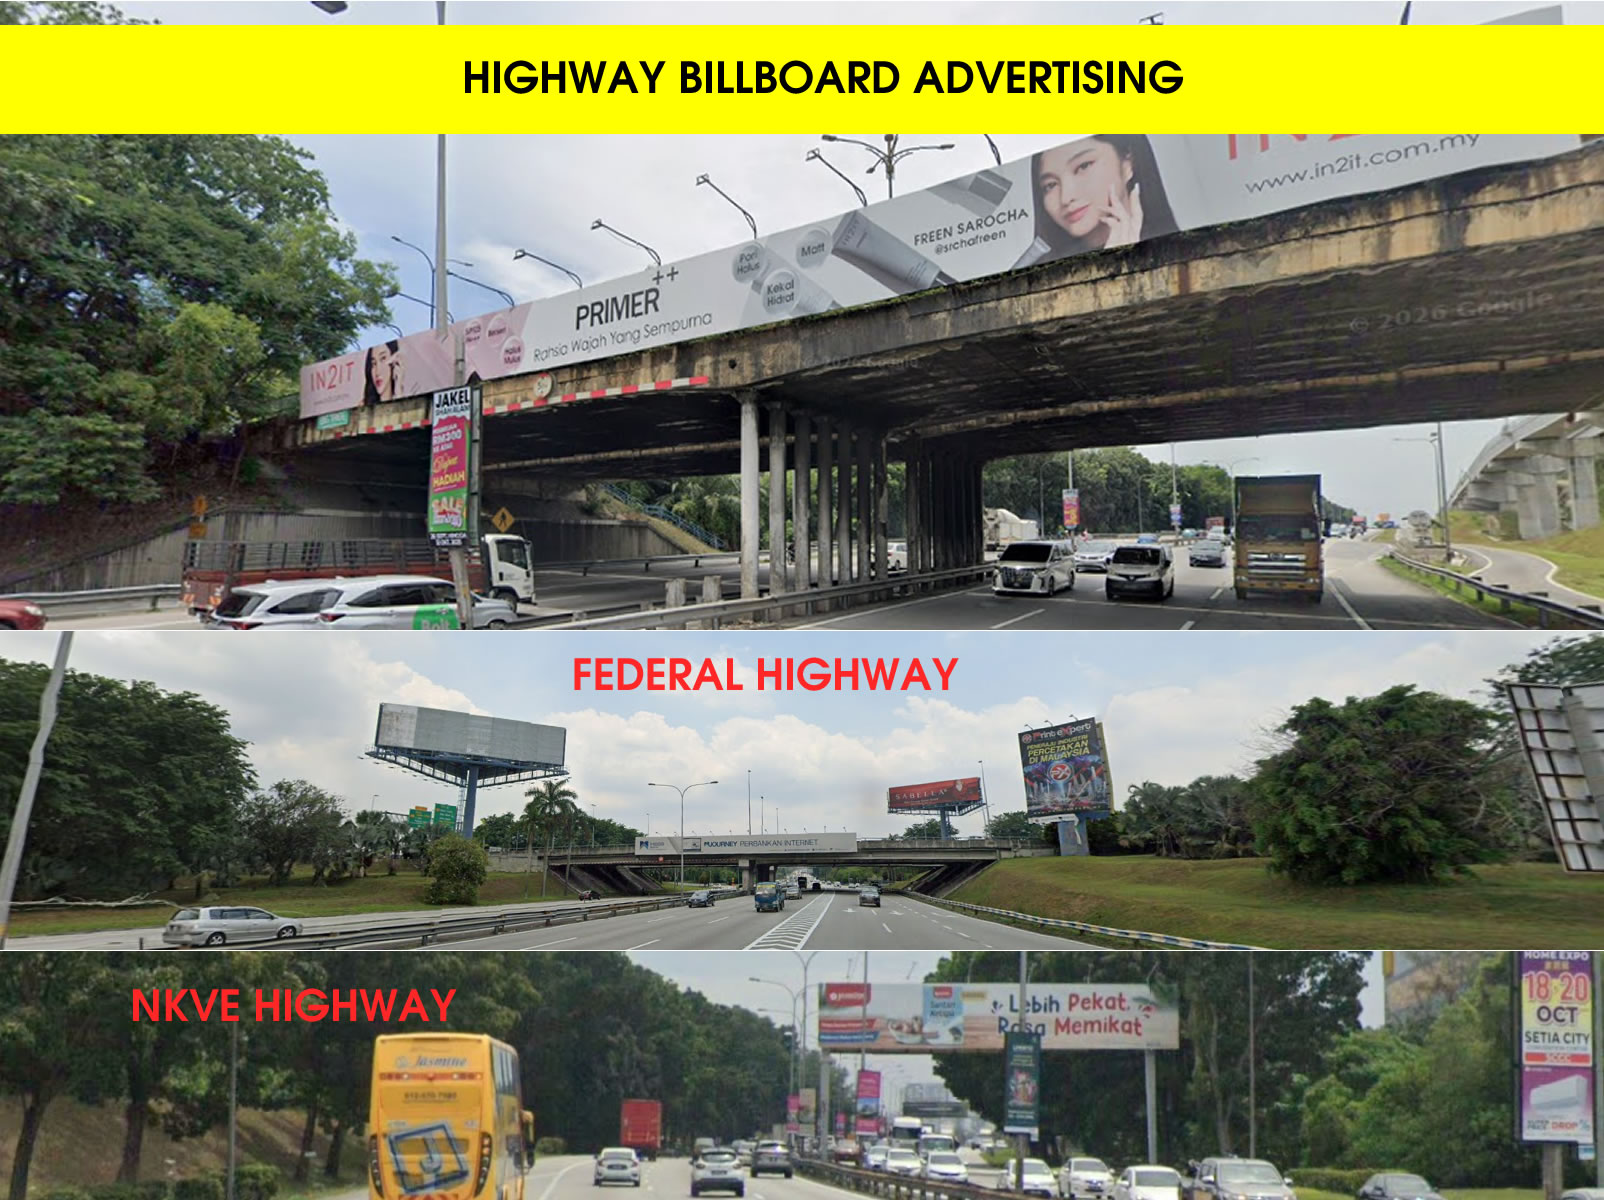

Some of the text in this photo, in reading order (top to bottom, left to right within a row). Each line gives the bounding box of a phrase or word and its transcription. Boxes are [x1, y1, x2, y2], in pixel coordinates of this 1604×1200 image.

[1246, 134, 1480, 193] www.in2it.com.my
[914, 208, 1029, 246] FREEN SAROCHA
[801, 243, 825, 257] Matt
[935, 229, 1006, 255] @srchafreen
[767, 279, 795, 295] Kekal
[767, 292, 795, 307] Hidrat
[575, 287, 660, 331] PRIMER
[533, 312, 713, 362] Rahsia Wajah Yang Sempurna
[311, 361, 355, 392] IN2IT
[436, 389, 469, 408] JAKEL
[1028, 740, 1088, 756] PERCETAKAN
[1041, 747, 1090, 762] MALAYSIA
[895, 788, 946, 801] SABELLA
[785, 838, 818, 846] INTERNET
[1524, 951, 1589, 961] HOME EXPO
[1537, 1005, 1579, 1023] OCT
[1054, 1014, 1142, 1037] Memikat
[1525, 1030, 1590, 1045] SETIA CITY
[414, 1054, 468, 1068] Jasmine
